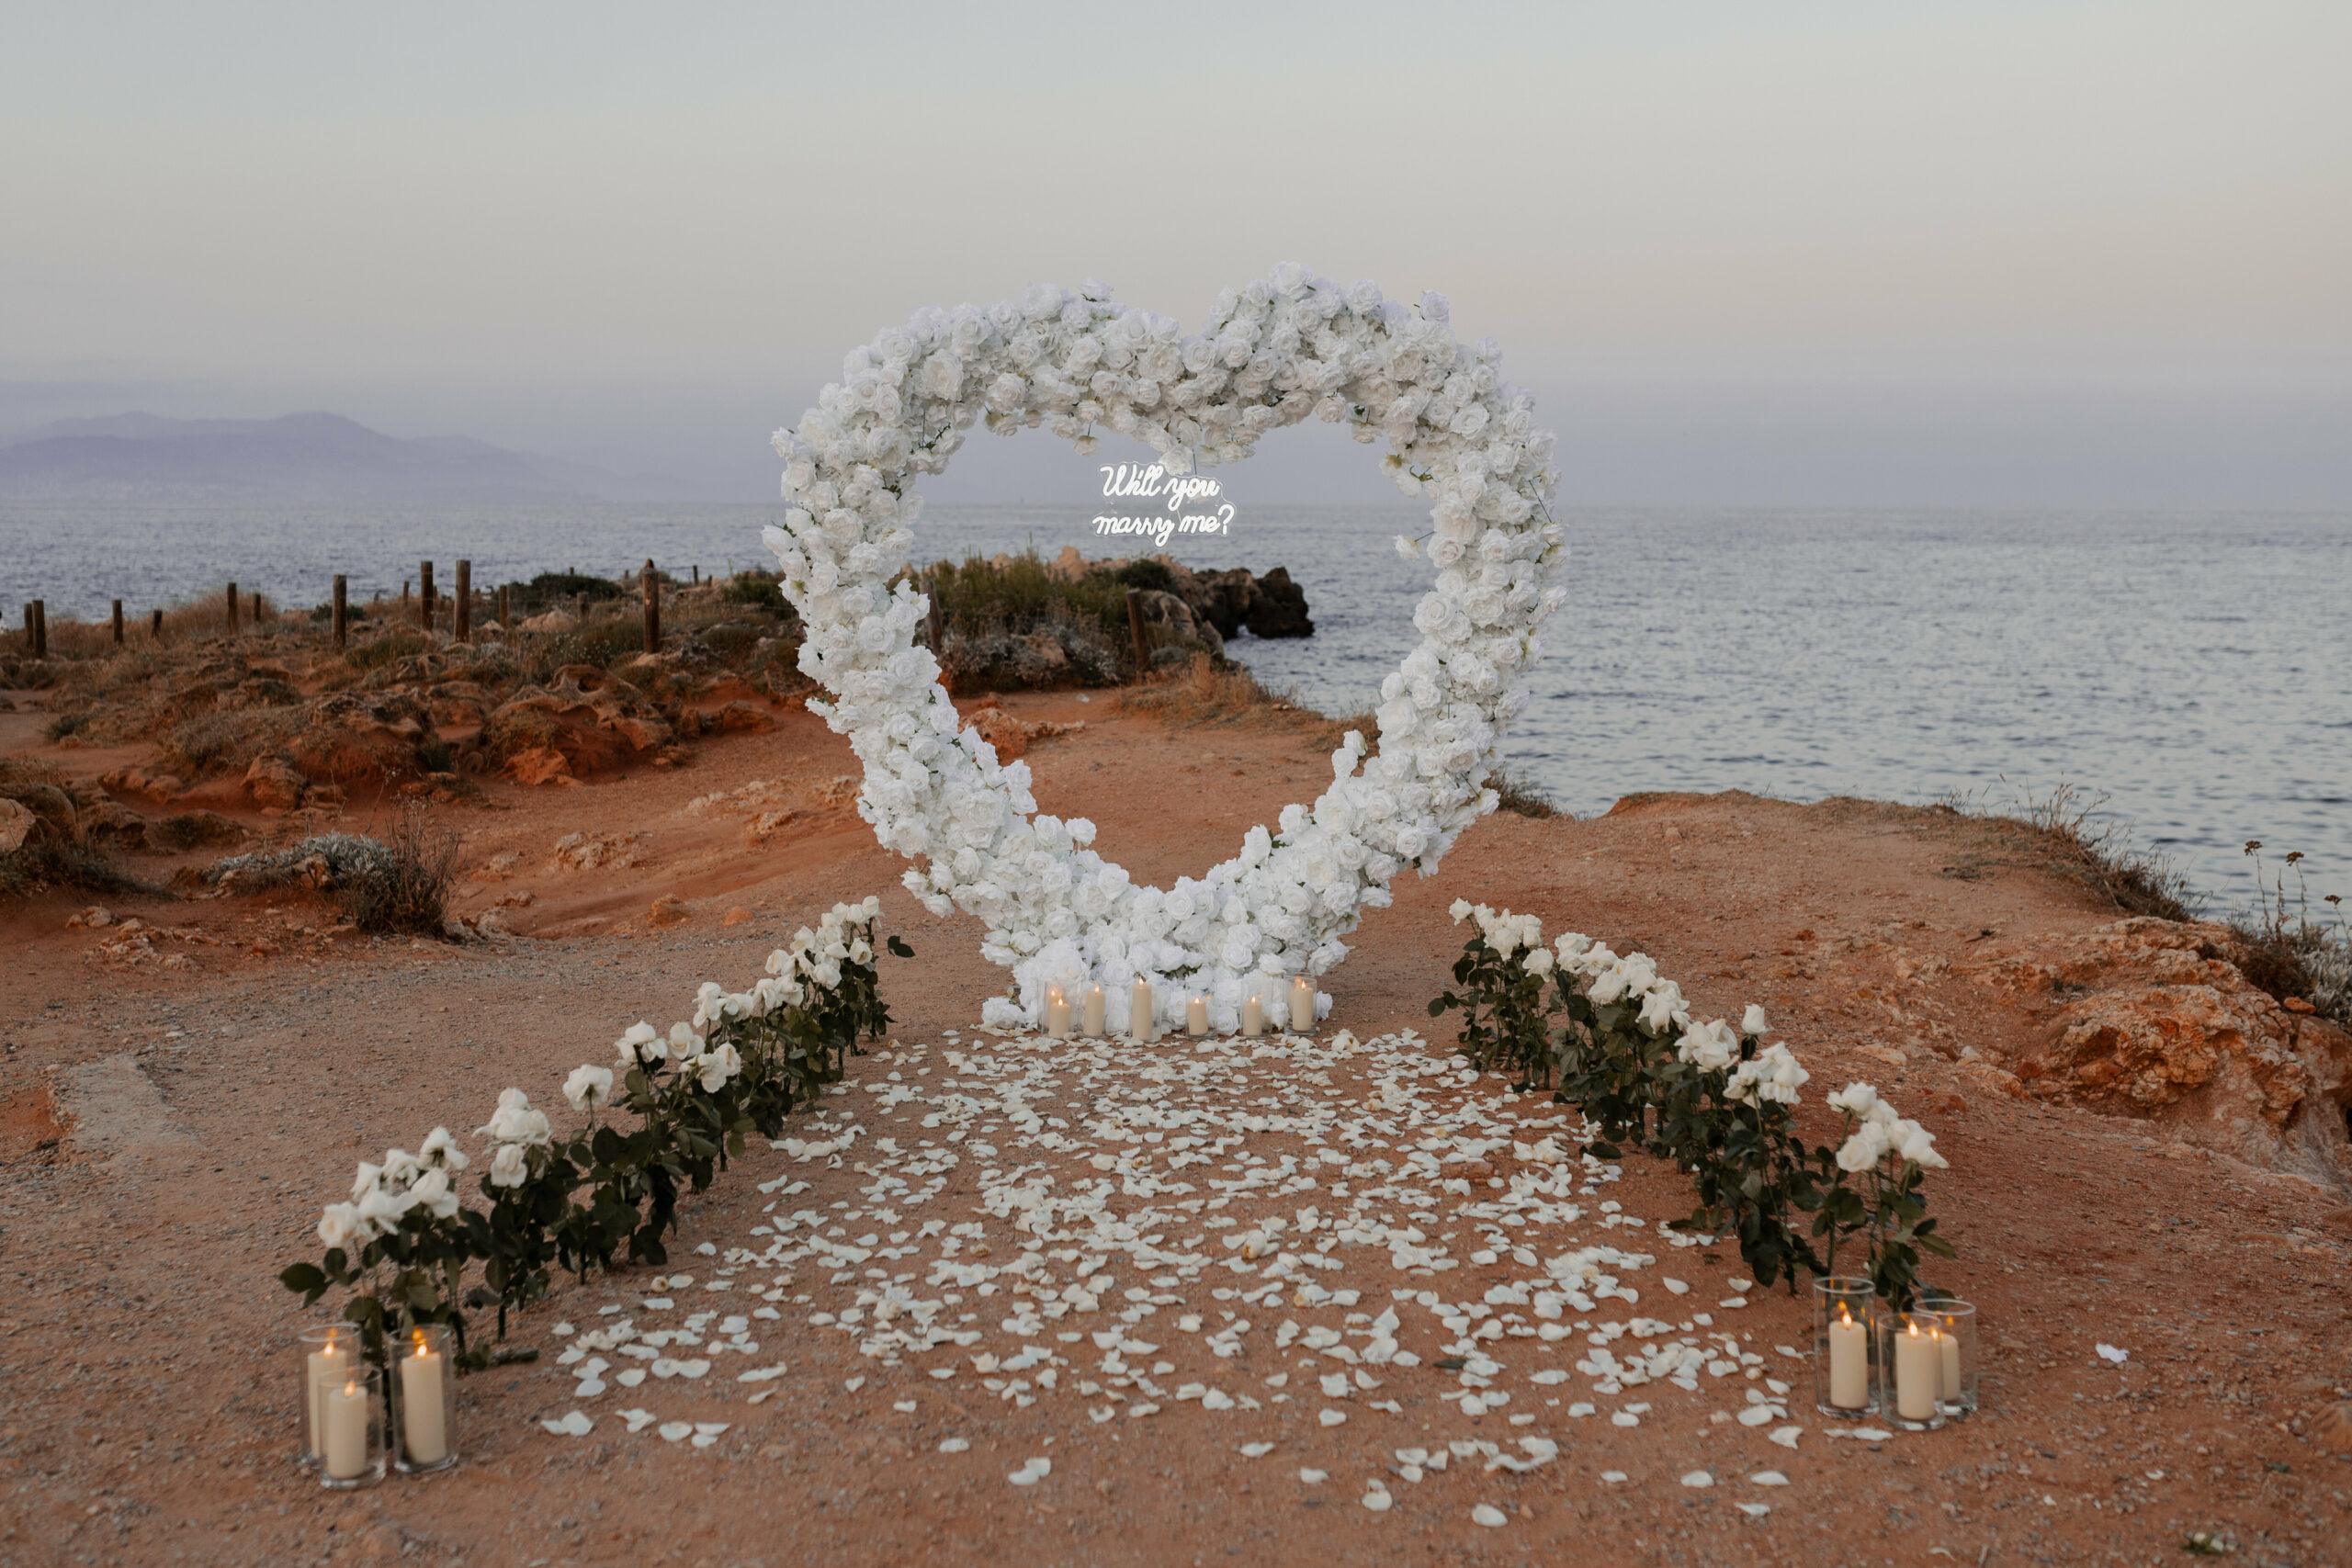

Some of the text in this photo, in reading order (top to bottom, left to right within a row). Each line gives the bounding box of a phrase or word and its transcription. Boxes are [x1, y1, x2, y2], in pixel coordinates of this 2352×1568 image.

[1100, 464, 1220, 512] Will you
[1092, 504, 1235, 547] marry me?
